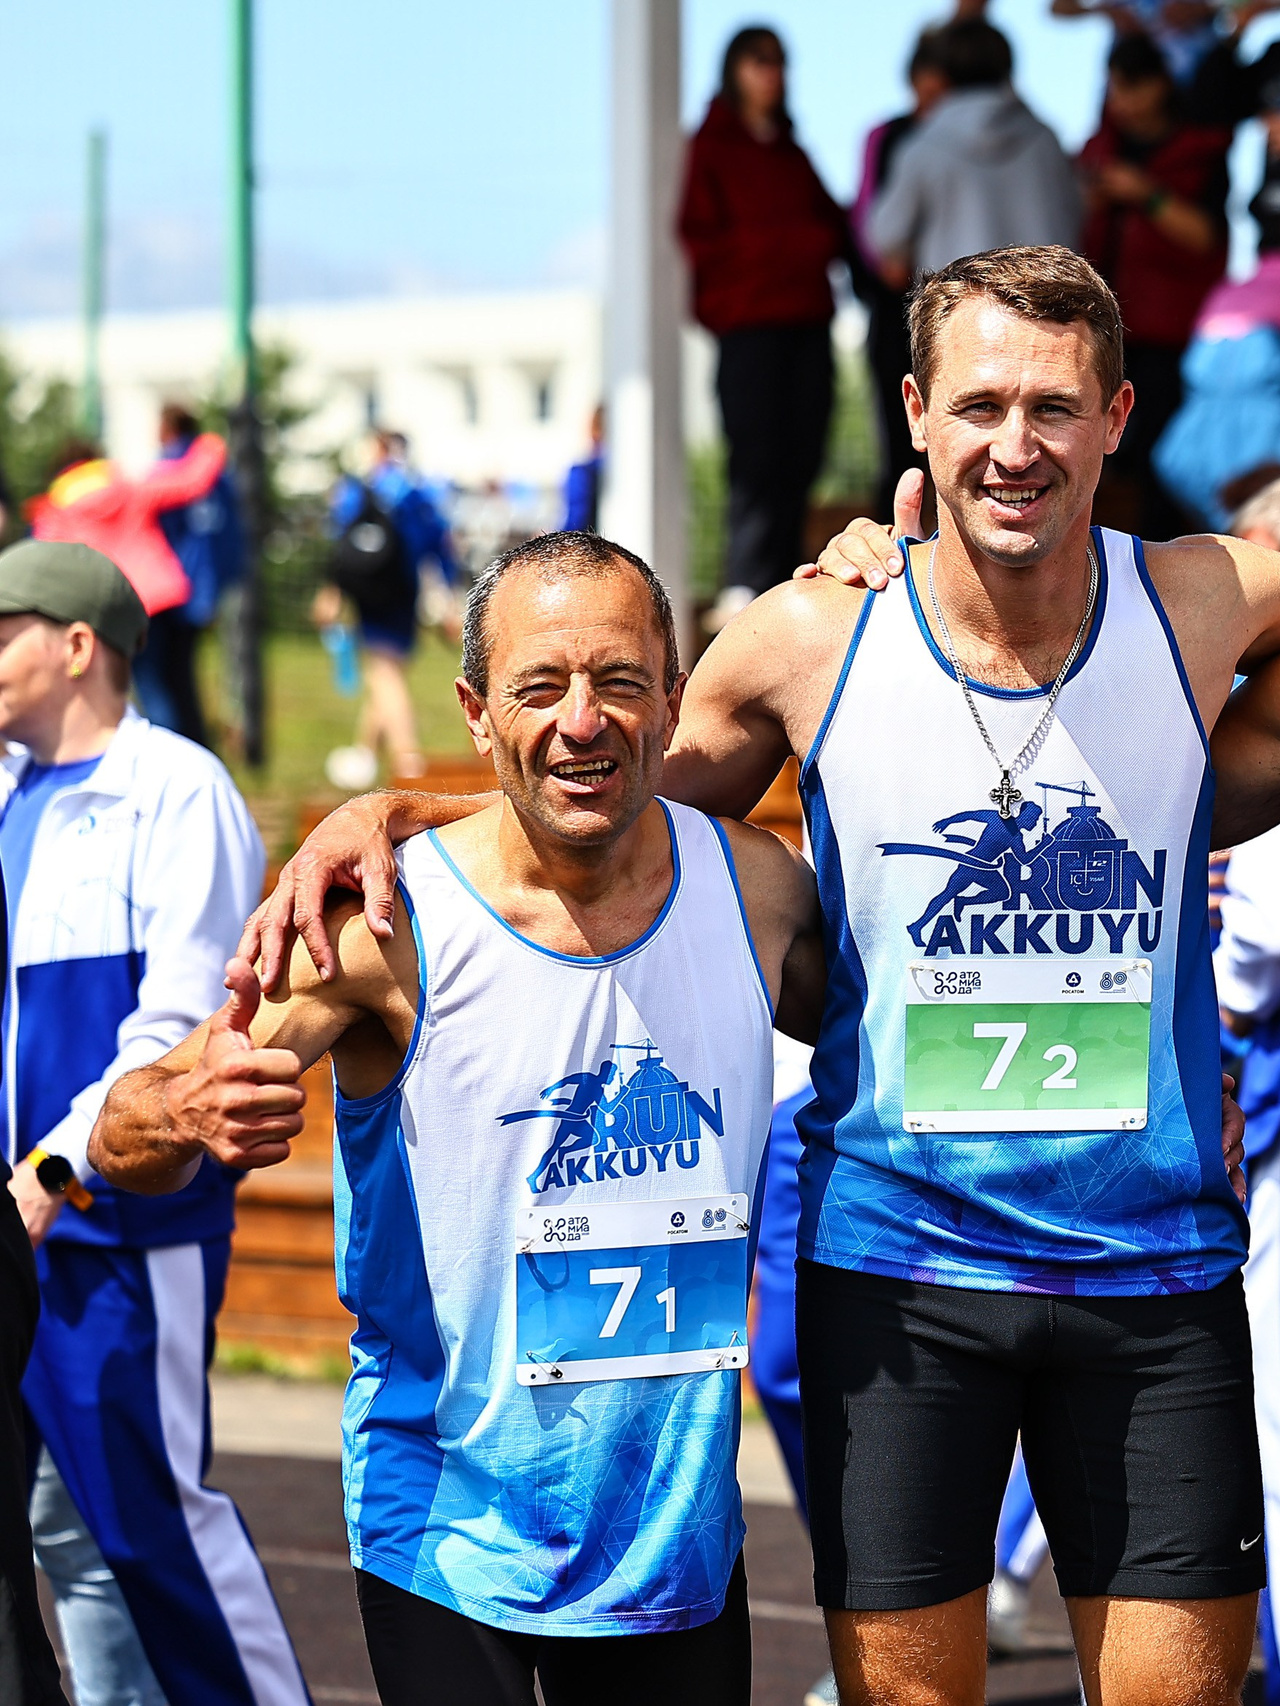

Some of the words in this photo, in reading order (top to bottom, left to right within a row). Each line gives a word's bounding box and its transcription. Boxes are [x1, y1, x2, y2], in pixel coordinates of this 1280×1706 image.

[1002, 849, 1168, 912] RUN
[924, 909, 1164, 957] AKKUYU
[973, 1022, 1027, 1090] 7
[1042, 1044, 1077, 1089] 2
[592, 1087, 725, 1153] RUN
[542, 1140, 701, 1192] AKKUYU
[589, 1266, 642, 1339] 7
[655, 1286, 676, 1333] 1
